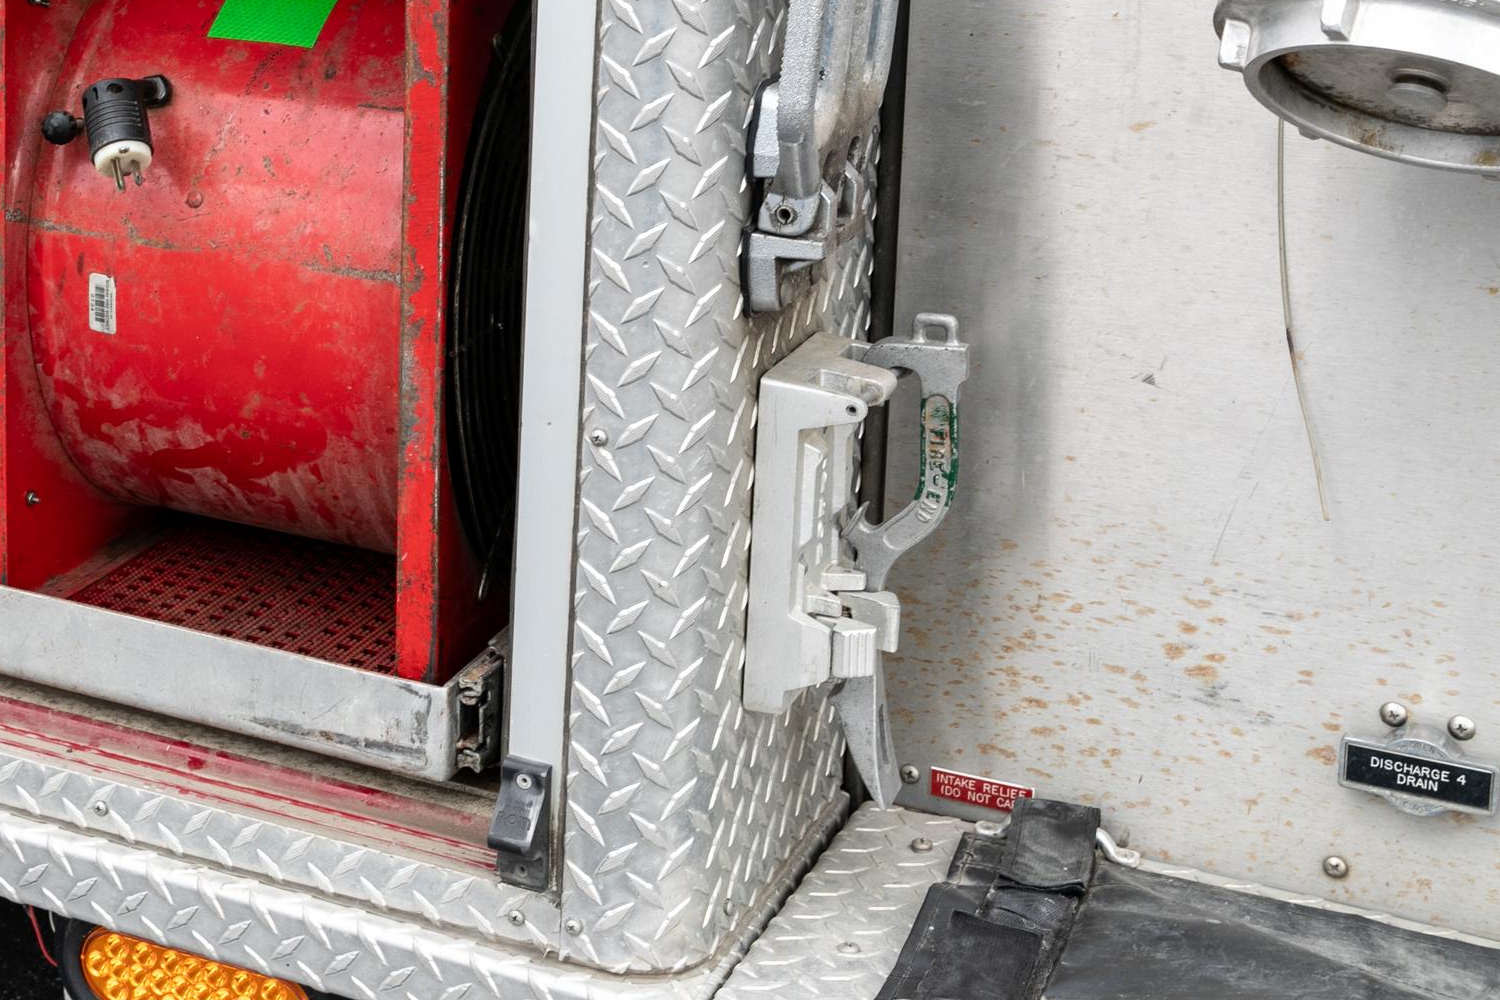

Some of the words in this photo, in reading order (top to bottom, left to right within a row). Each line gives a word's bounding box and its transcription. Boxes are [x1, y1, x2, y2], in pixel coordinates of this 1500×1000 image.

[1369, 756, 1451, 782] DISCHARGE
[1456, 774, 1467, 786] 4
[936, 773, 977, 790] INTAKE
[1396, 773, 1439, 792] DRAIN
[940, 785, 962, 798] (DO
[967, 791, 992, 804] NOT
